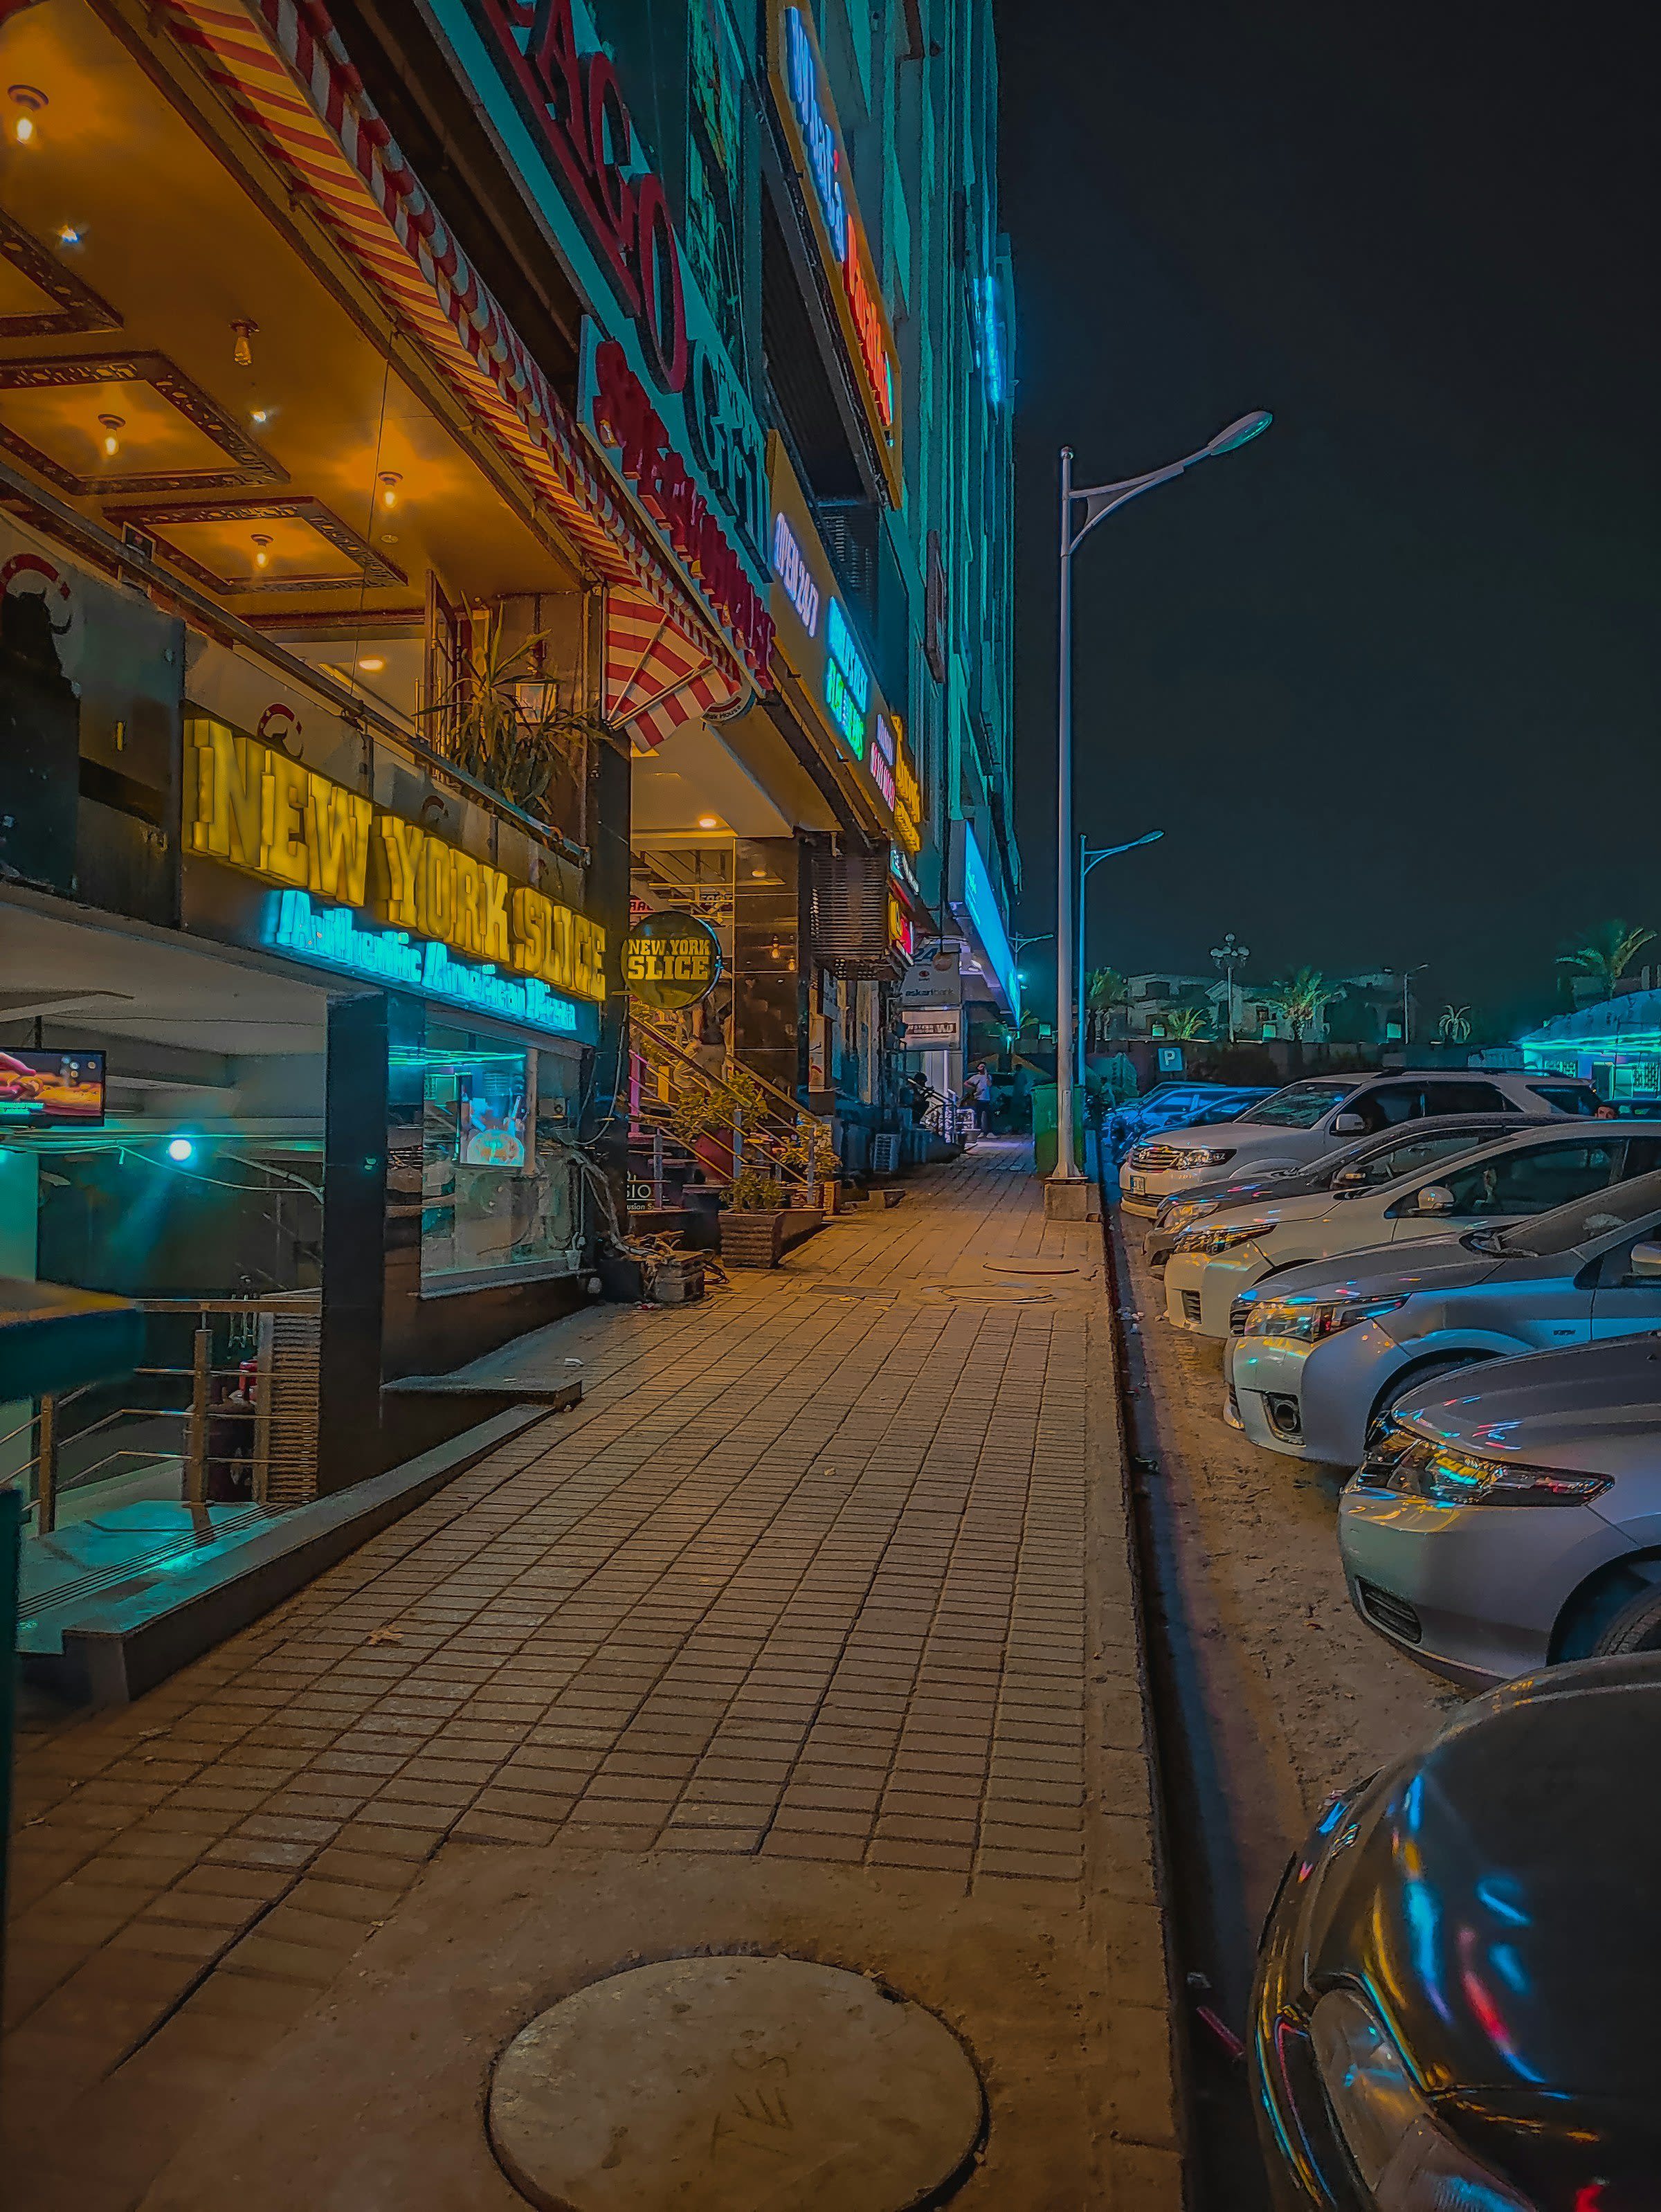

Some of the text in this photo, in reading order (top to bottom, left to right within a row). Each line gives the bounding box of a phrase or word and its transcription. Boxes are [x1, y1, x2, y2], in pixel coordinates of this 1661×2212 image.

[184, 718, 606, 1001] NEW YORK SLICE
[275, 889, 422, 982] Authentic
[421, 941, 526, 1015] American
[628, 939, 711, 955] NEW YORK
[628, 956, 709, 980] SLICE
[1163, 1049, 1175, 1066] P
